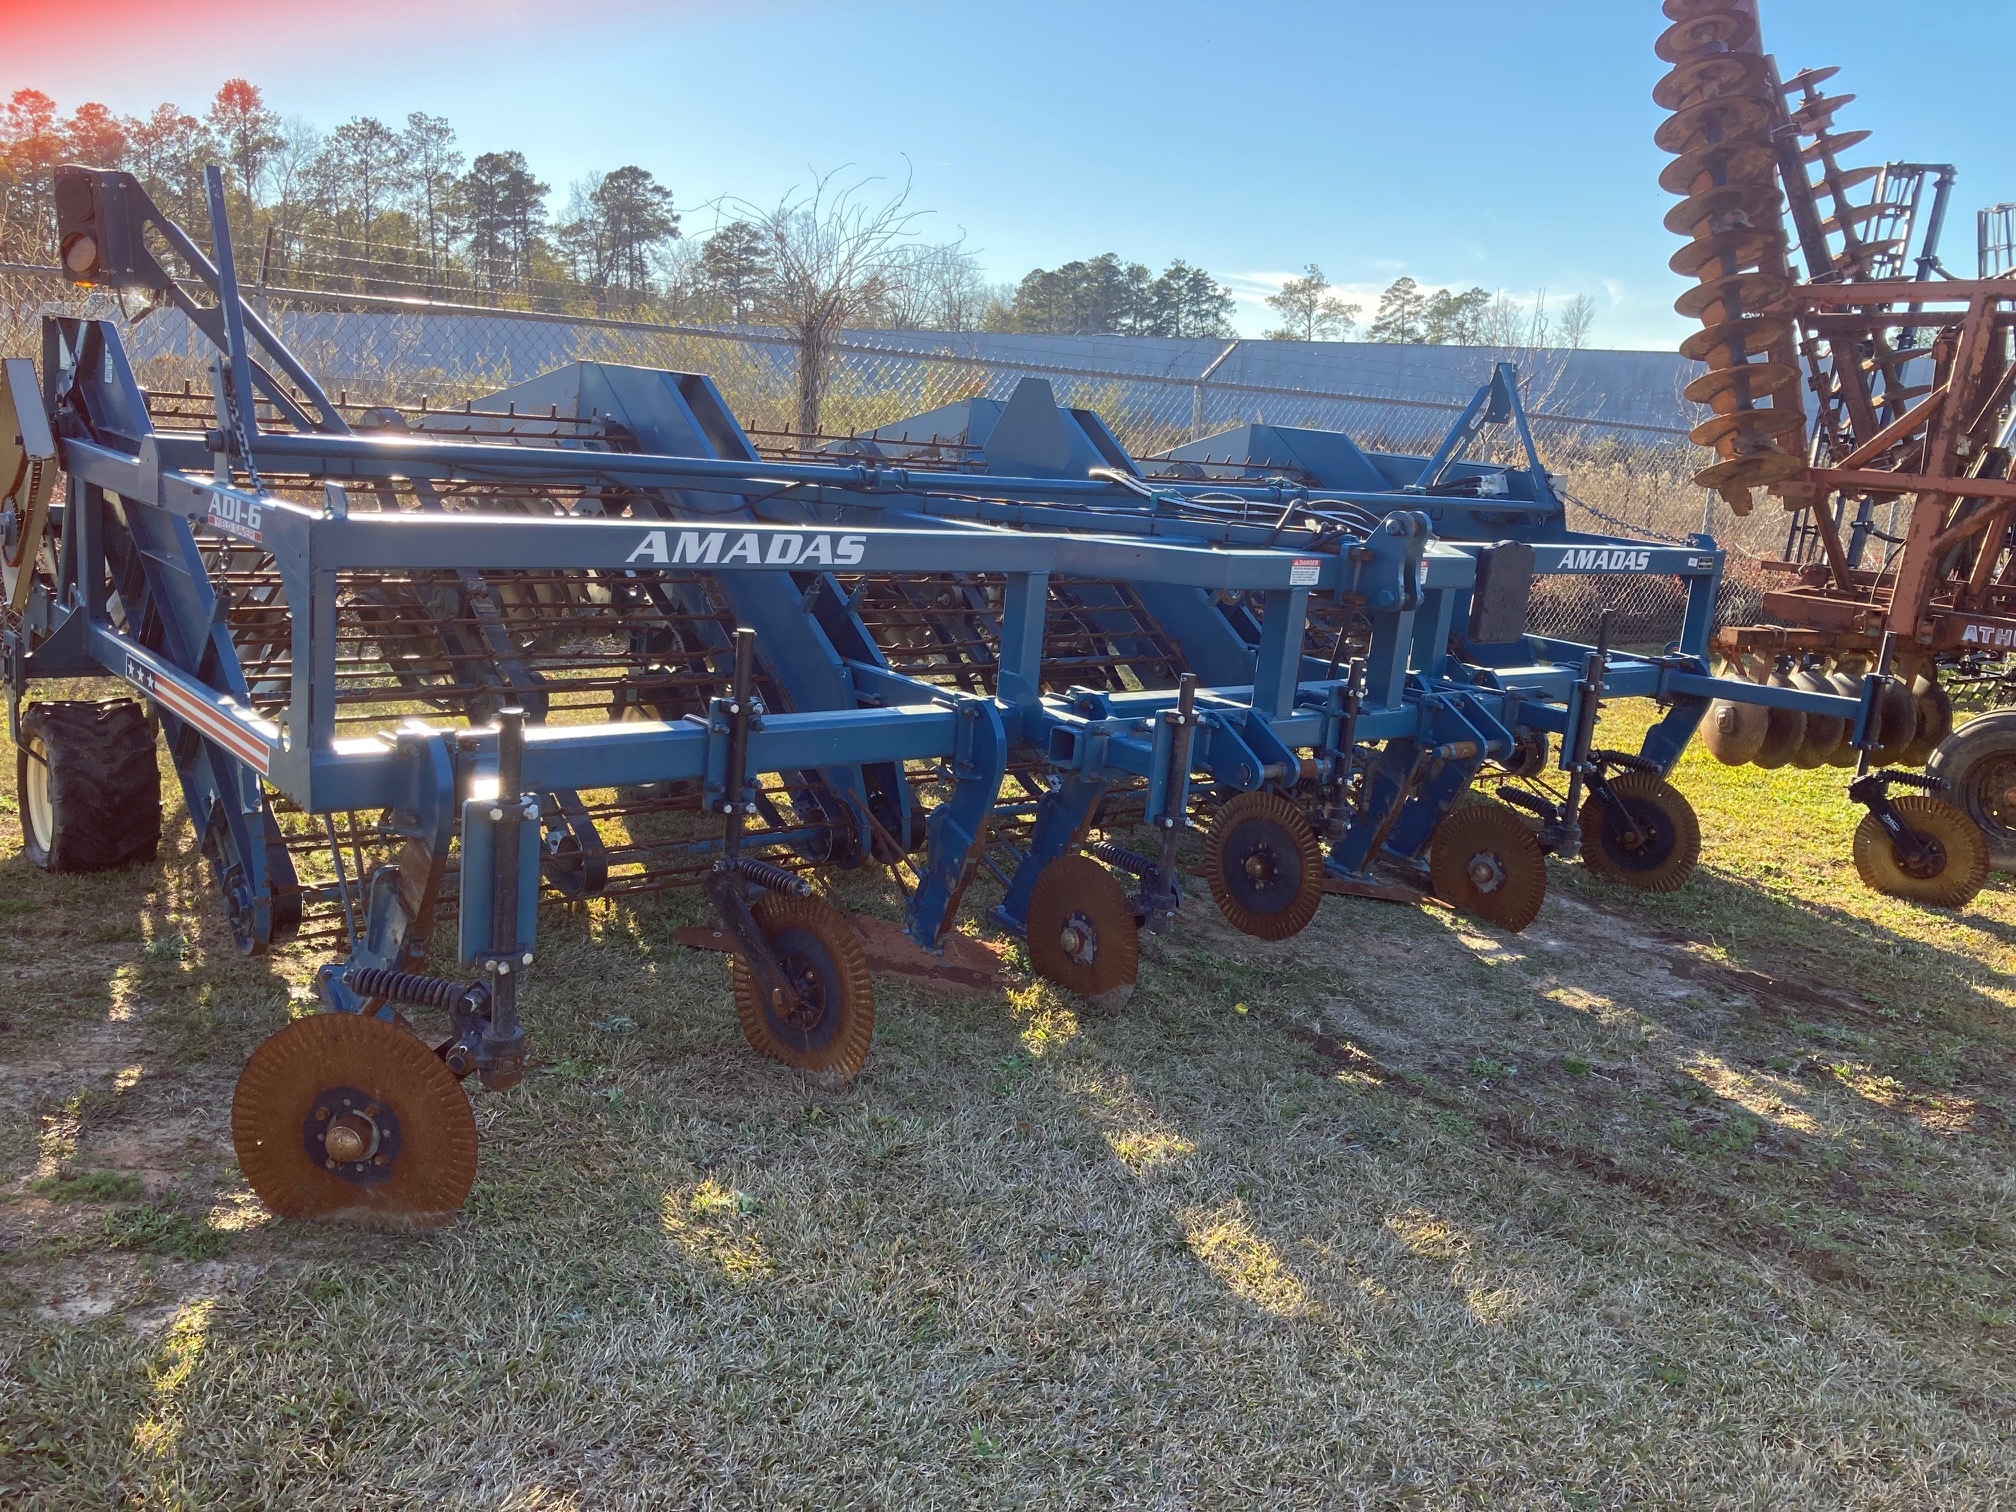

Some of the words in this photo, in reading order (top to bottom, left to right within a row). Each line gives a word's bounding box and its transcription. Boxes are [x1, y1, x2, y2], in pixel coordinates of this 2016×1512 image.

[208, 492, 262, 530] ADI-6
[625, 530, 867, 565] AMADAS
[1557, 549, 1651, 571] AMADAS
[1299, 559, 1320, 567] DANGER
